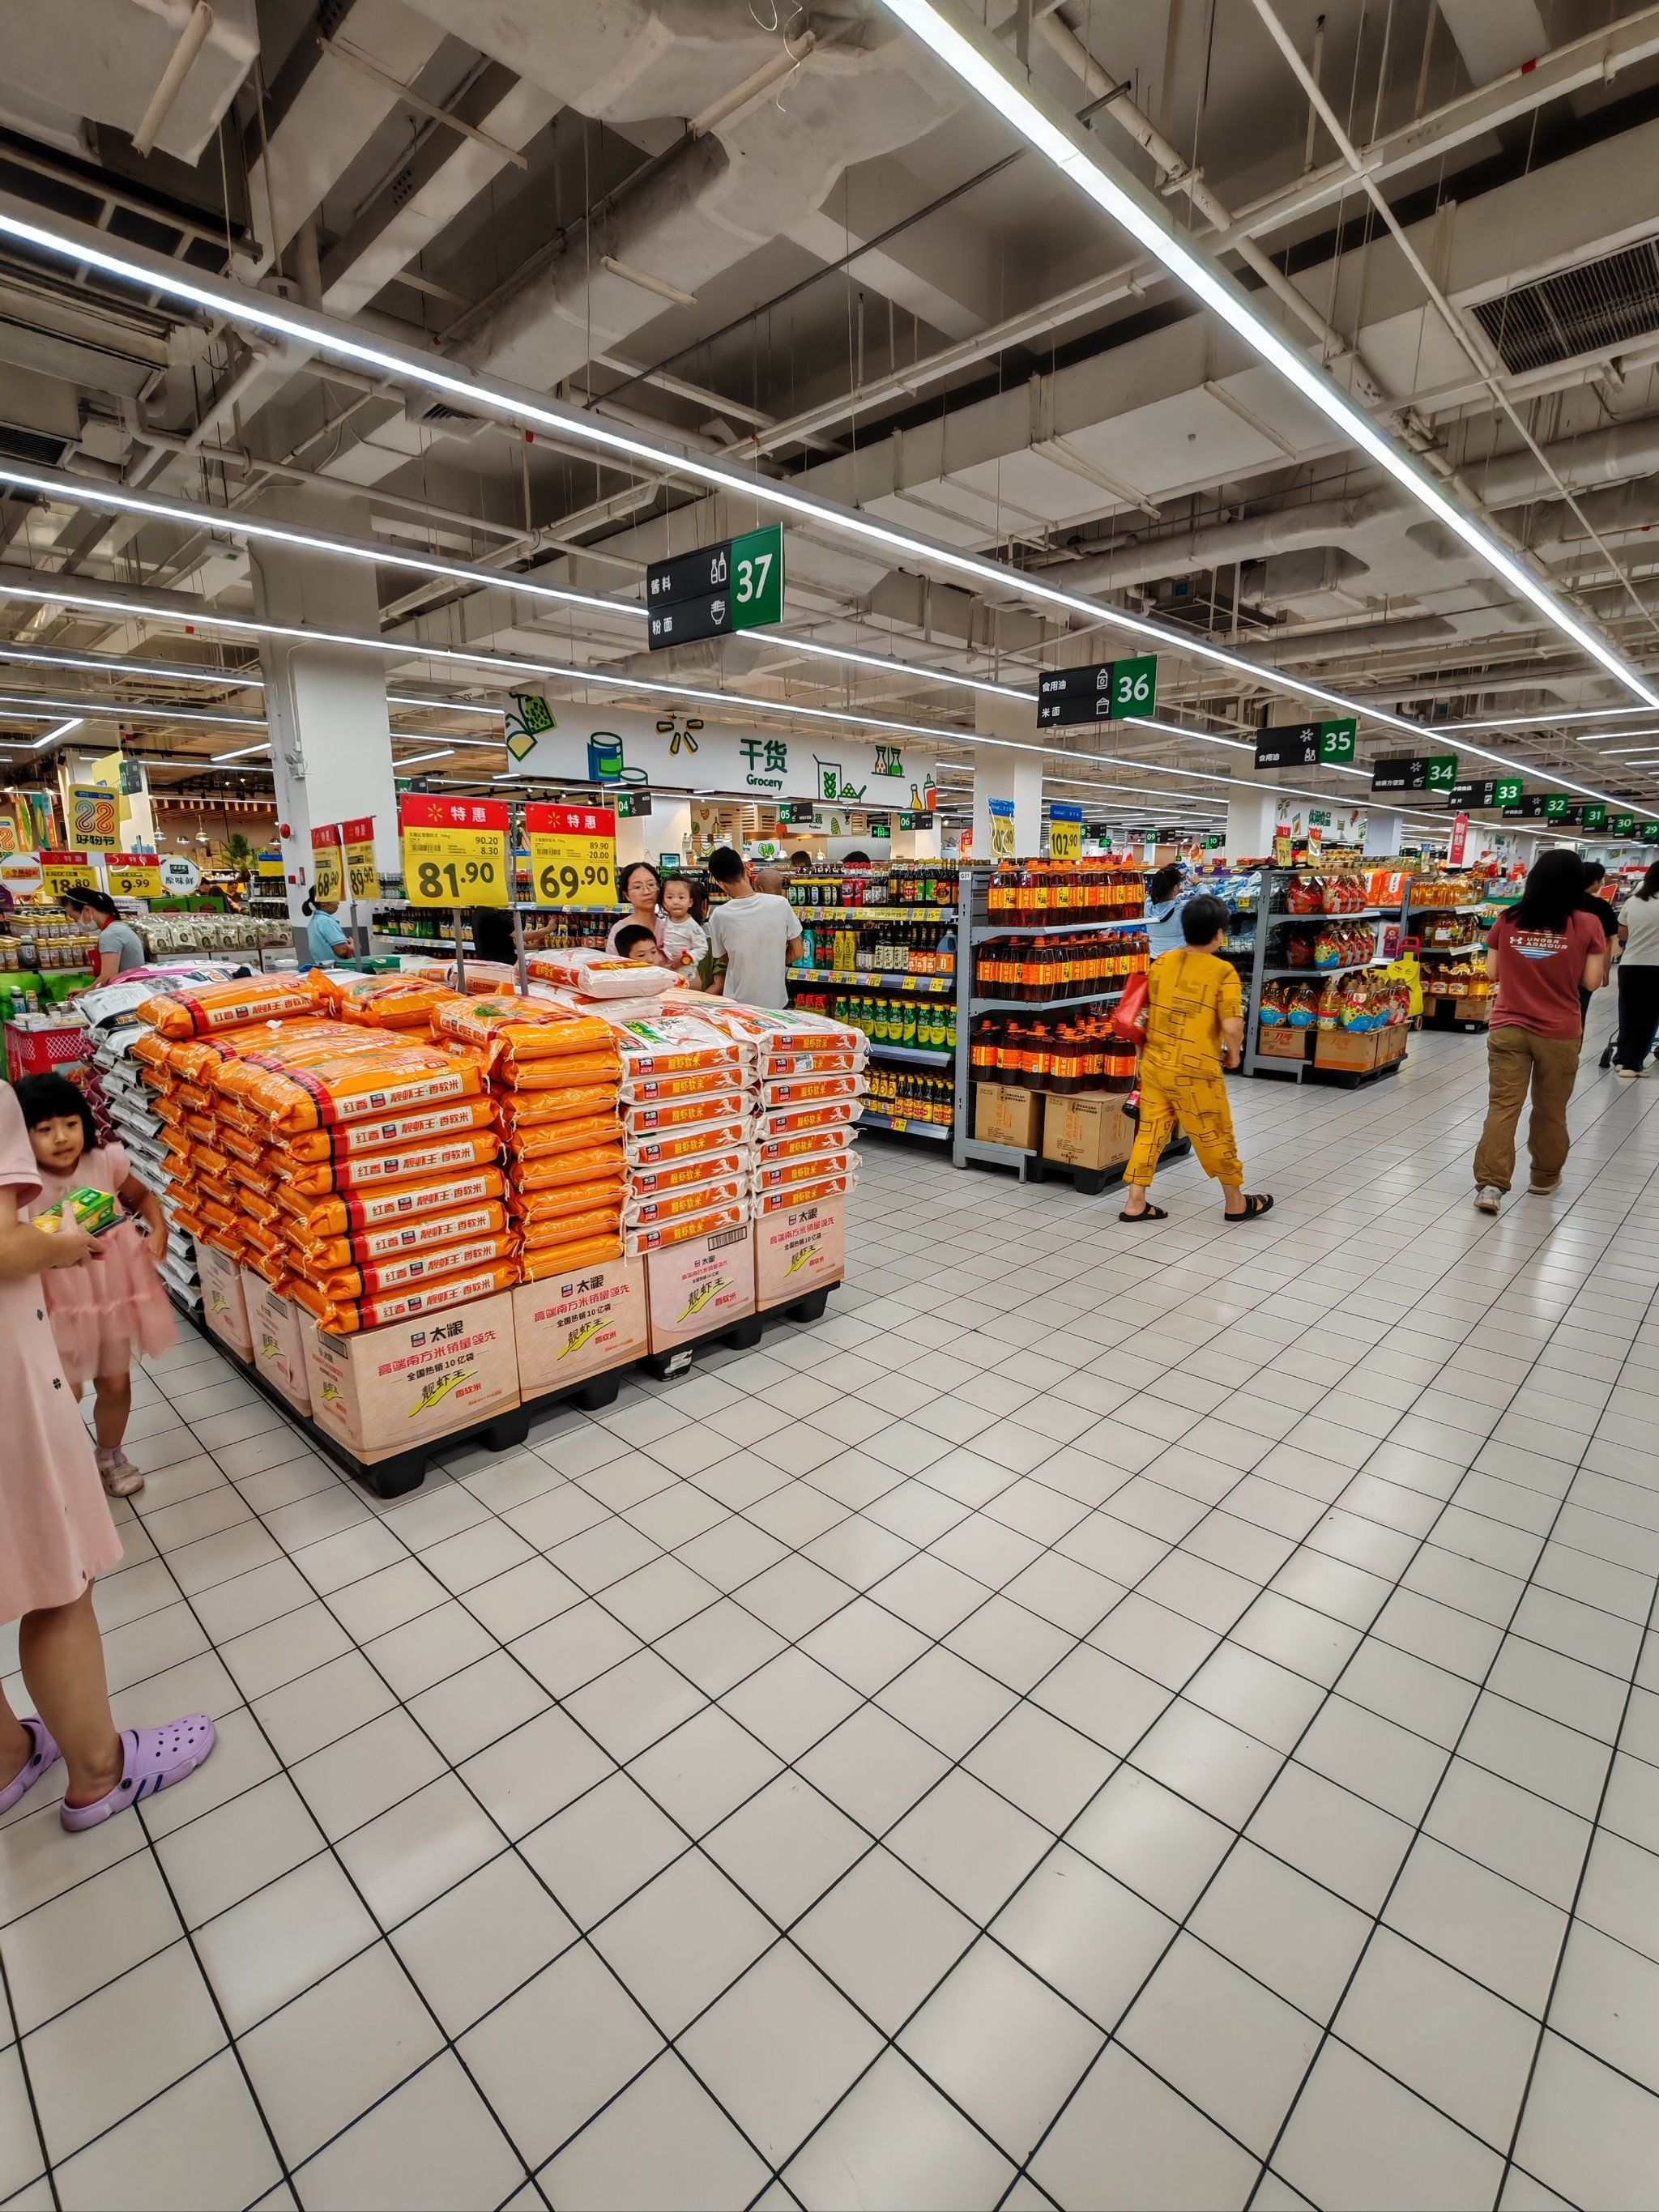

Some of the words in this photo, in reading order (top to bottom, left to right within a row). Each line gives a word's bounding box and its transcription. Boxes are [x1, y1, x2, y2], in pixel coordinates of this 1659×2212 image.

[650, 575, 672, 595] 酱料
[736, 554, 773, 603] 37
[652, 616, 672, 635] 粉面
[1043, 680, 1067, 693] 食用油
[1117, 673, 1149, 703] 36
[1042, 706, 1060, 718] 米面
[1324, 731, 1351, 752] 35
[740, 738, 788, 774] 干货
[1430, 765, 1453, 781] 34
[746, 774, 783, 791] Grocery
[1499, 786, 1517, 799] 33
[619, 800, 629, 811] 04
[1549, 800, 1565, 812] 32
[450, 806, 486, 822] 特惠
[567, 814, 596, 829] 特惠
[780, 809, 790, 819] 05
[901, 817, 911, 827] 06
[1589, 811, 1601, 820] 31
[1617, 819, 1631, 828] 30
[1645, 826, 1657, 834] 29
[76, 834, 115, 846] 好物节
[476, 837, 498, 845] 90.20
[1051, 833, 1077, 855] 102.90
[480, 847, 498, 855] 8.30
[51, 879, 90, 893] 18.80
[122, 879, 150, 893] 9.99
[318, 871, 339, 897] 68.90
[350, 867, 374, 895] 89.90
[418, 862, 494, 898] 81.90
[540, 865, 609, 899] 69.90
[799, 1208, 817, 1222] 太粮
[577, 1275, 603, 1294] 太粮
[535, 1284, 630, 1322] 高端南方米销量领先
[429, 1320, 464, 1343] 太粮
[568, 1318, 603, 1347] 靓虾王
[595, 1331, 616, 1345] 香软米
[377, 1330, 497, 1377] 高端南方米销量领先
[421, 1369, 466, 1404] 靓虾王
[455, 1383, 482, 1398] 香软米
